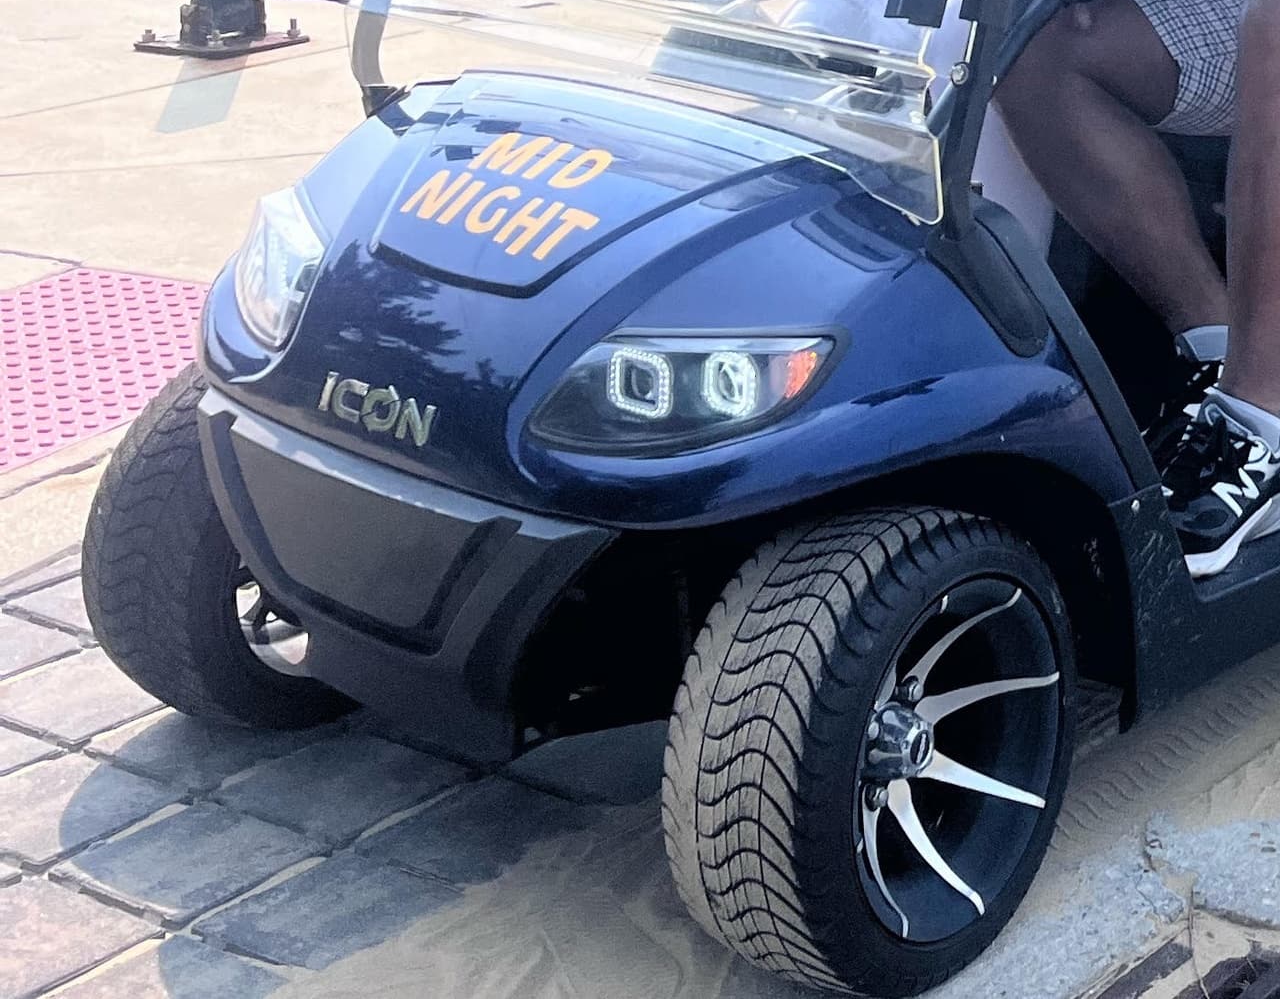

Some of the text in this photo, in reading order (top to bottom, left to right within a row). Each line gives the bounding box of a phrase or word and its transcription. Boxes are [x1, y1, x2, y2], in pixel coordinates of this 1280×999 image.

[467, 132, 614, 189] MID
[400, 169, 600, 261] NIGHT
[318, 371, 437, 447] ICON
